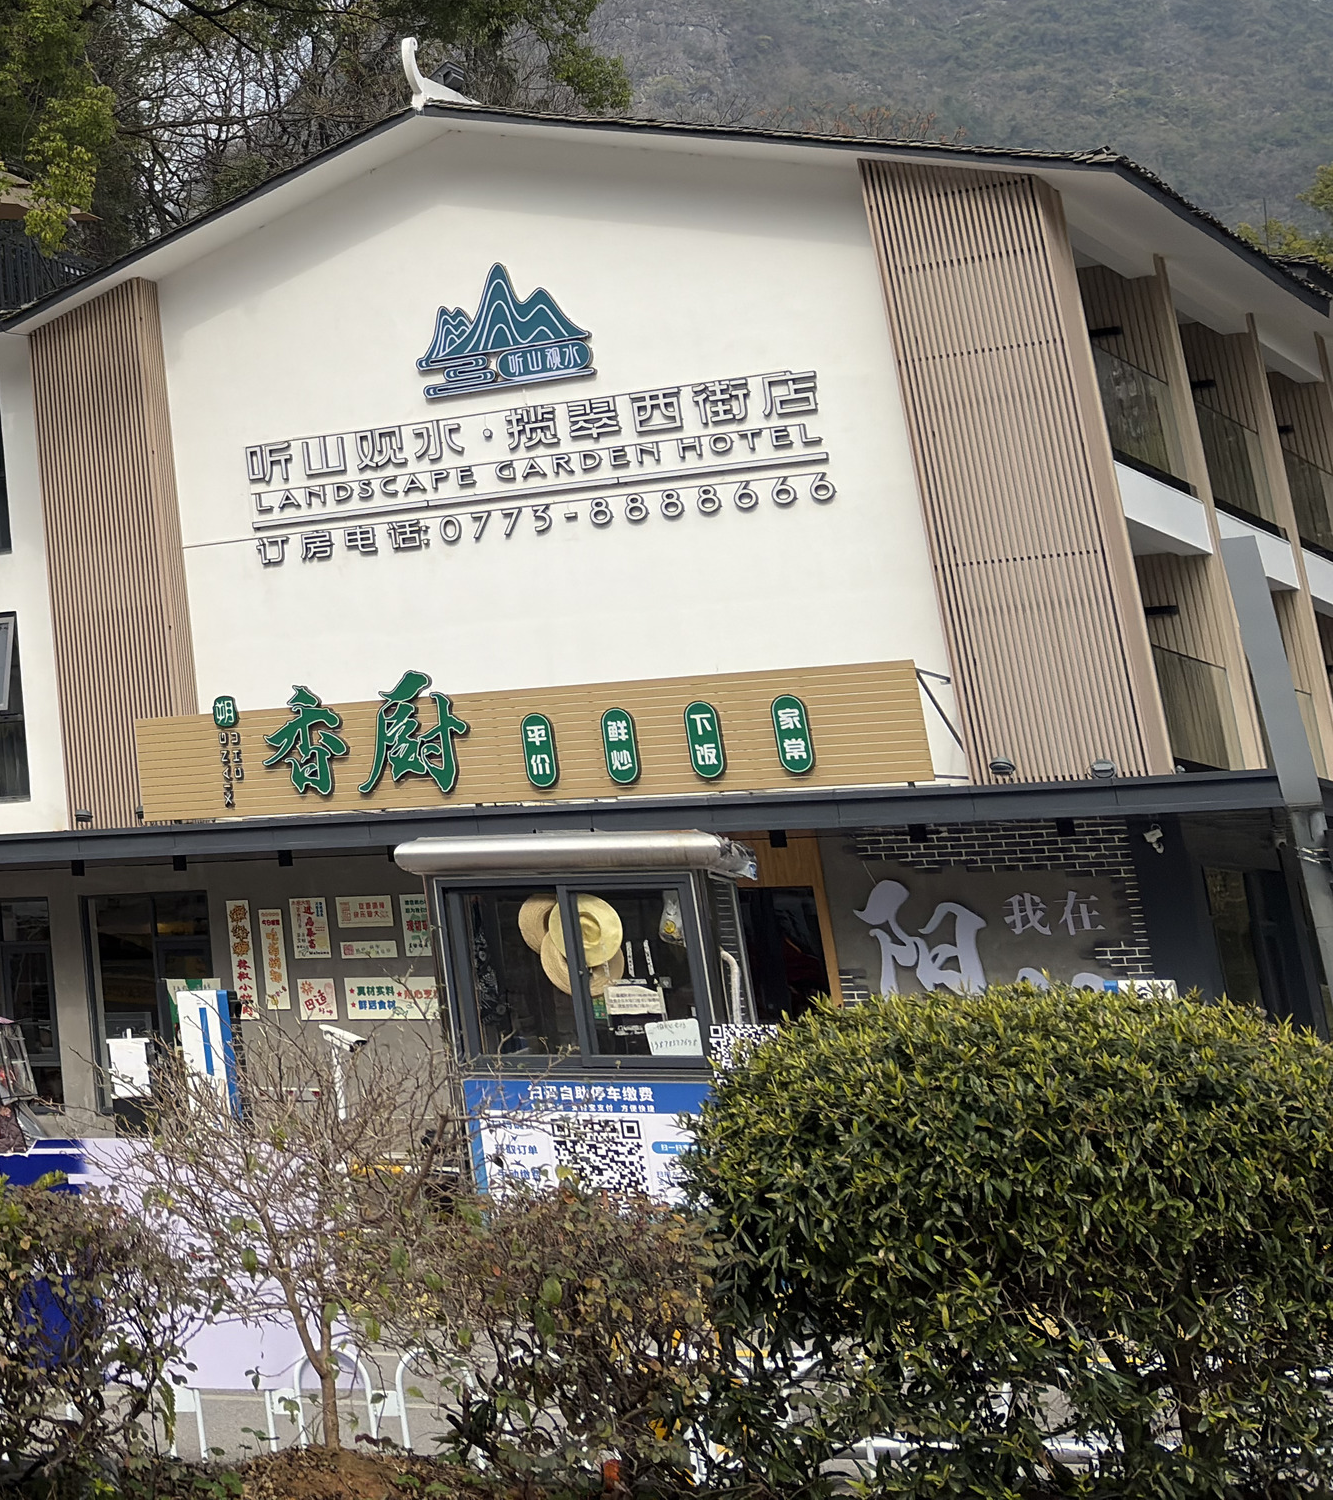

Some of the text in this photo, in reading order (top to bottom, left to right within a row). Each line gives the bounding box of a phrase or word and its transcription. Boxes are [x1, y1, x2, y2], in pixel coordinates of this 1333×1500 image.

[508, 350, 581, 374] 听山观水
[253, 425, 824, 514] LANDSCAPE GARDEN HOTEL
[214, 698, 238, 727] 朔
[264, 671, 469, 794] 香厨
[778, 708, 808, 761] 家常
[233, 731, 242, 780] CHU
[524, 725, 552, 776] 平价
[606, 719, 633, 772] 鲜炒
[689, 713, 719, 767] 下饭
[221, 731, 235, 807] XIANG
[1004, 891, 1106, 936] 我在
[357, 986, 395, 996] 真材实料
